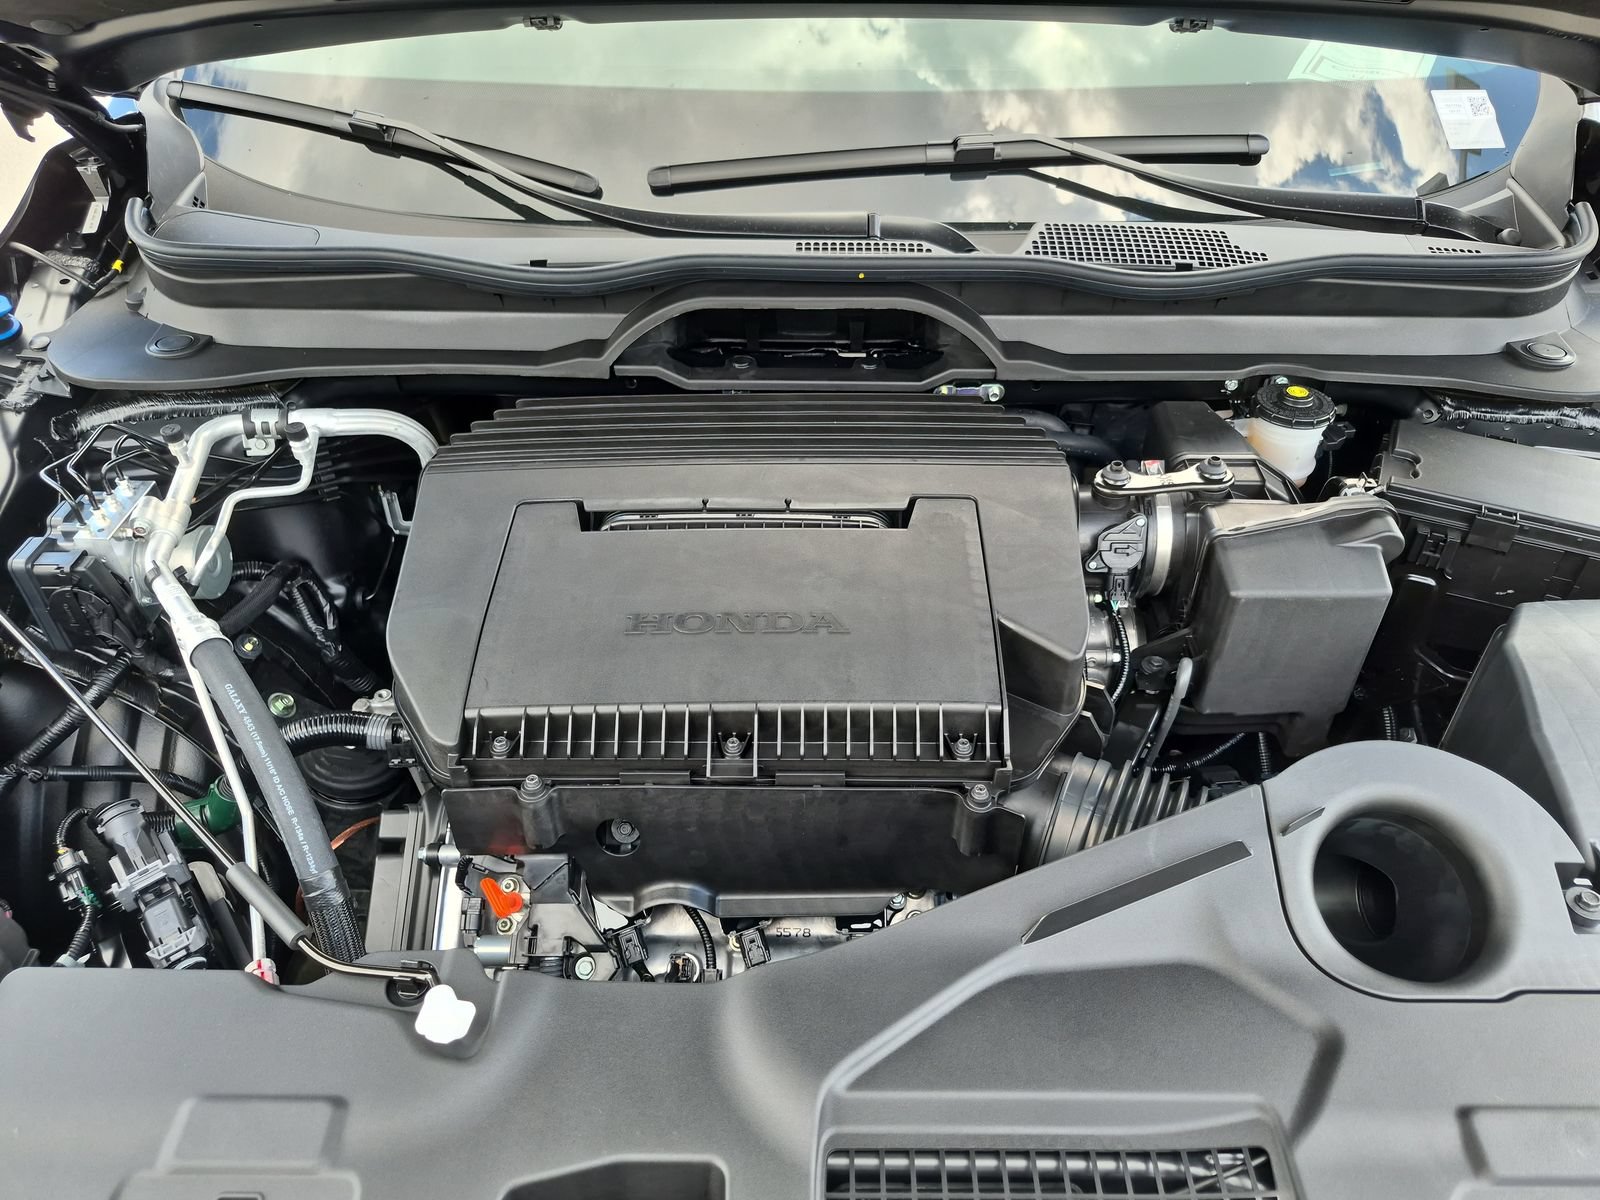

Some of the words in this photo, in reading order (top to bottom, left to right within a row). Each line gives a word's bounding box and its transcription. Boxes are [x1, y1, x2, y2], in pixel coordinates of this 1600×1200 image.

[623, 611, 851, 635] HONDA
[224, 683, 247, 715] GALAXY
[243, 715, 255, 731] 4843
[272, 775, 280, 784] ID
[276, 784, 286, 796] A/C
[281, 795, 295, 816] HOSE
[291, 817, 304, 841] R-134a
[775, 927, 811, 938] 5578
